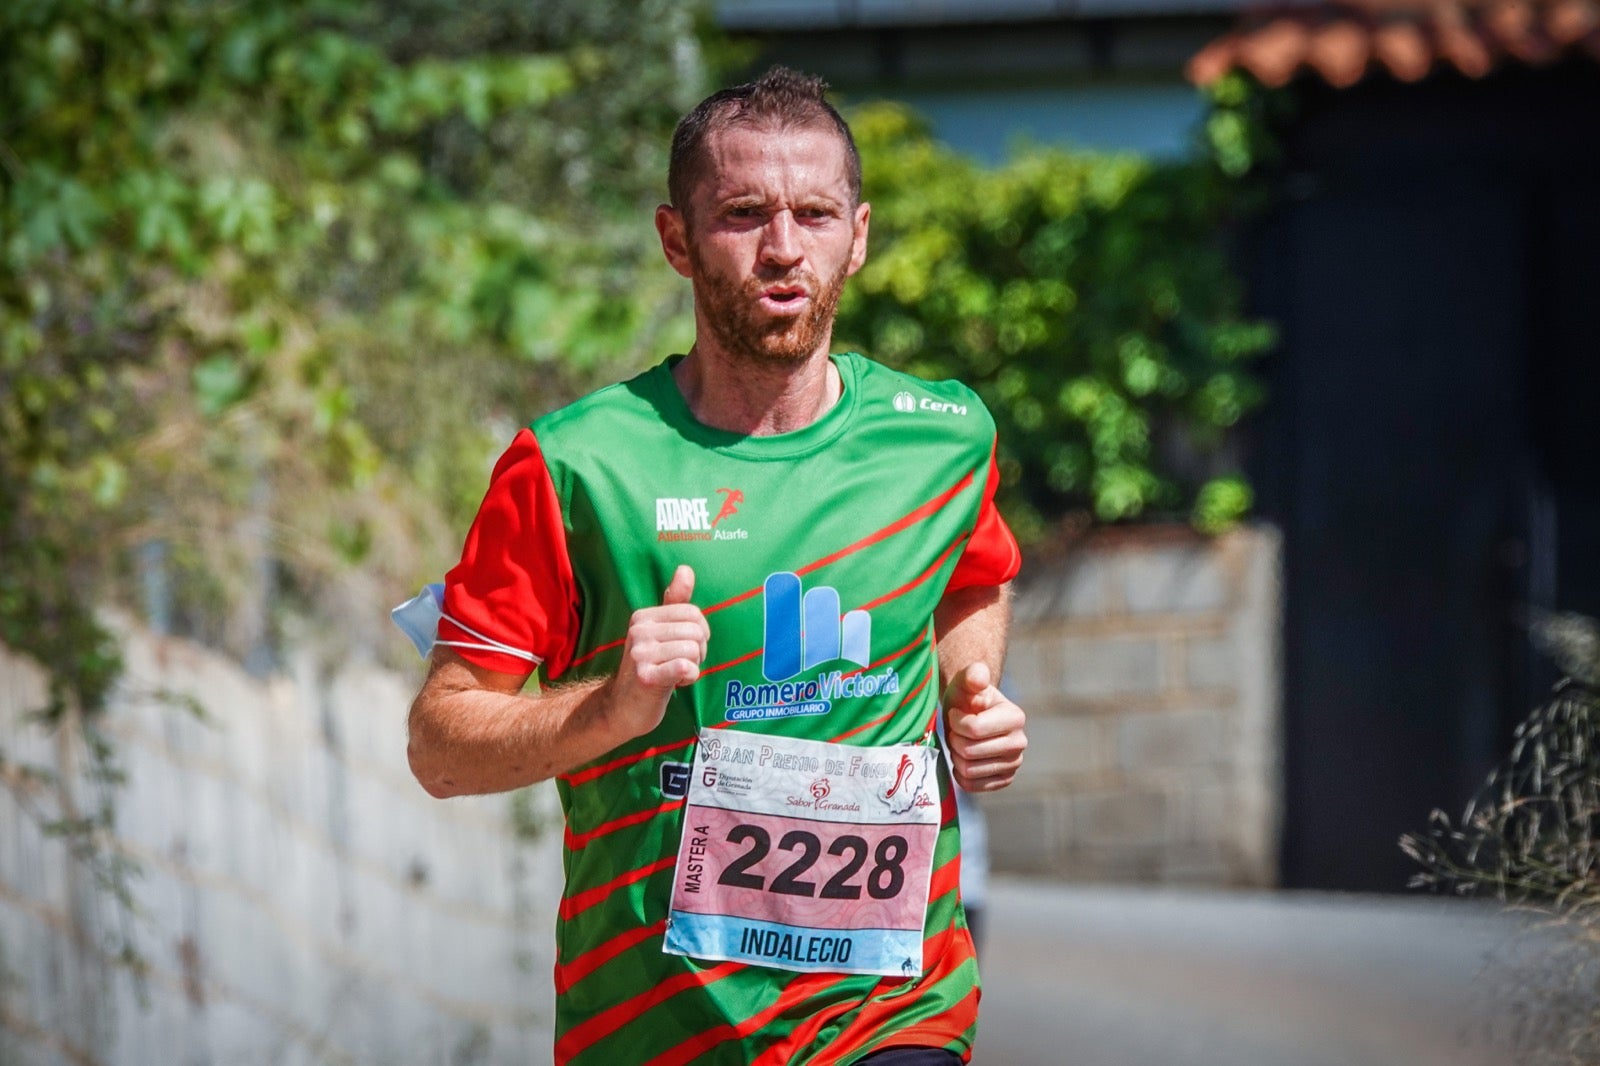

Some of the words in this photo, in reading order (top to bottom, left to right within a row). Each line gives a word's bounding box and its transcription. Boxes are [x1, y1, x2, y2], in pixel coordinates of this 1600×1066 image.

[920, 398, 967, 415] Cervi
[656, 498, 711, 531] ATARFE
[658, 531, 712, 542] Atletismo
[714, 528, 748, 540] Atarfe
[733, 709, 764, 720] GRUPO
[766, 704, 826, 718] INMOBILIARIO
[708, 738, 754, 765] GRAN
[760, 745, 819, 773] PREMIO
[825, 758, 845, 776] DE
[785, 795, 813, 809] Sabor
[819, 799, 861, 812] Granada
[684, 837, 707, 894] MASTER
[700, 825, 710, 836] A
[717, 823, 909, 900] 2228
[740, 927, 852, 964] INDALECIO
